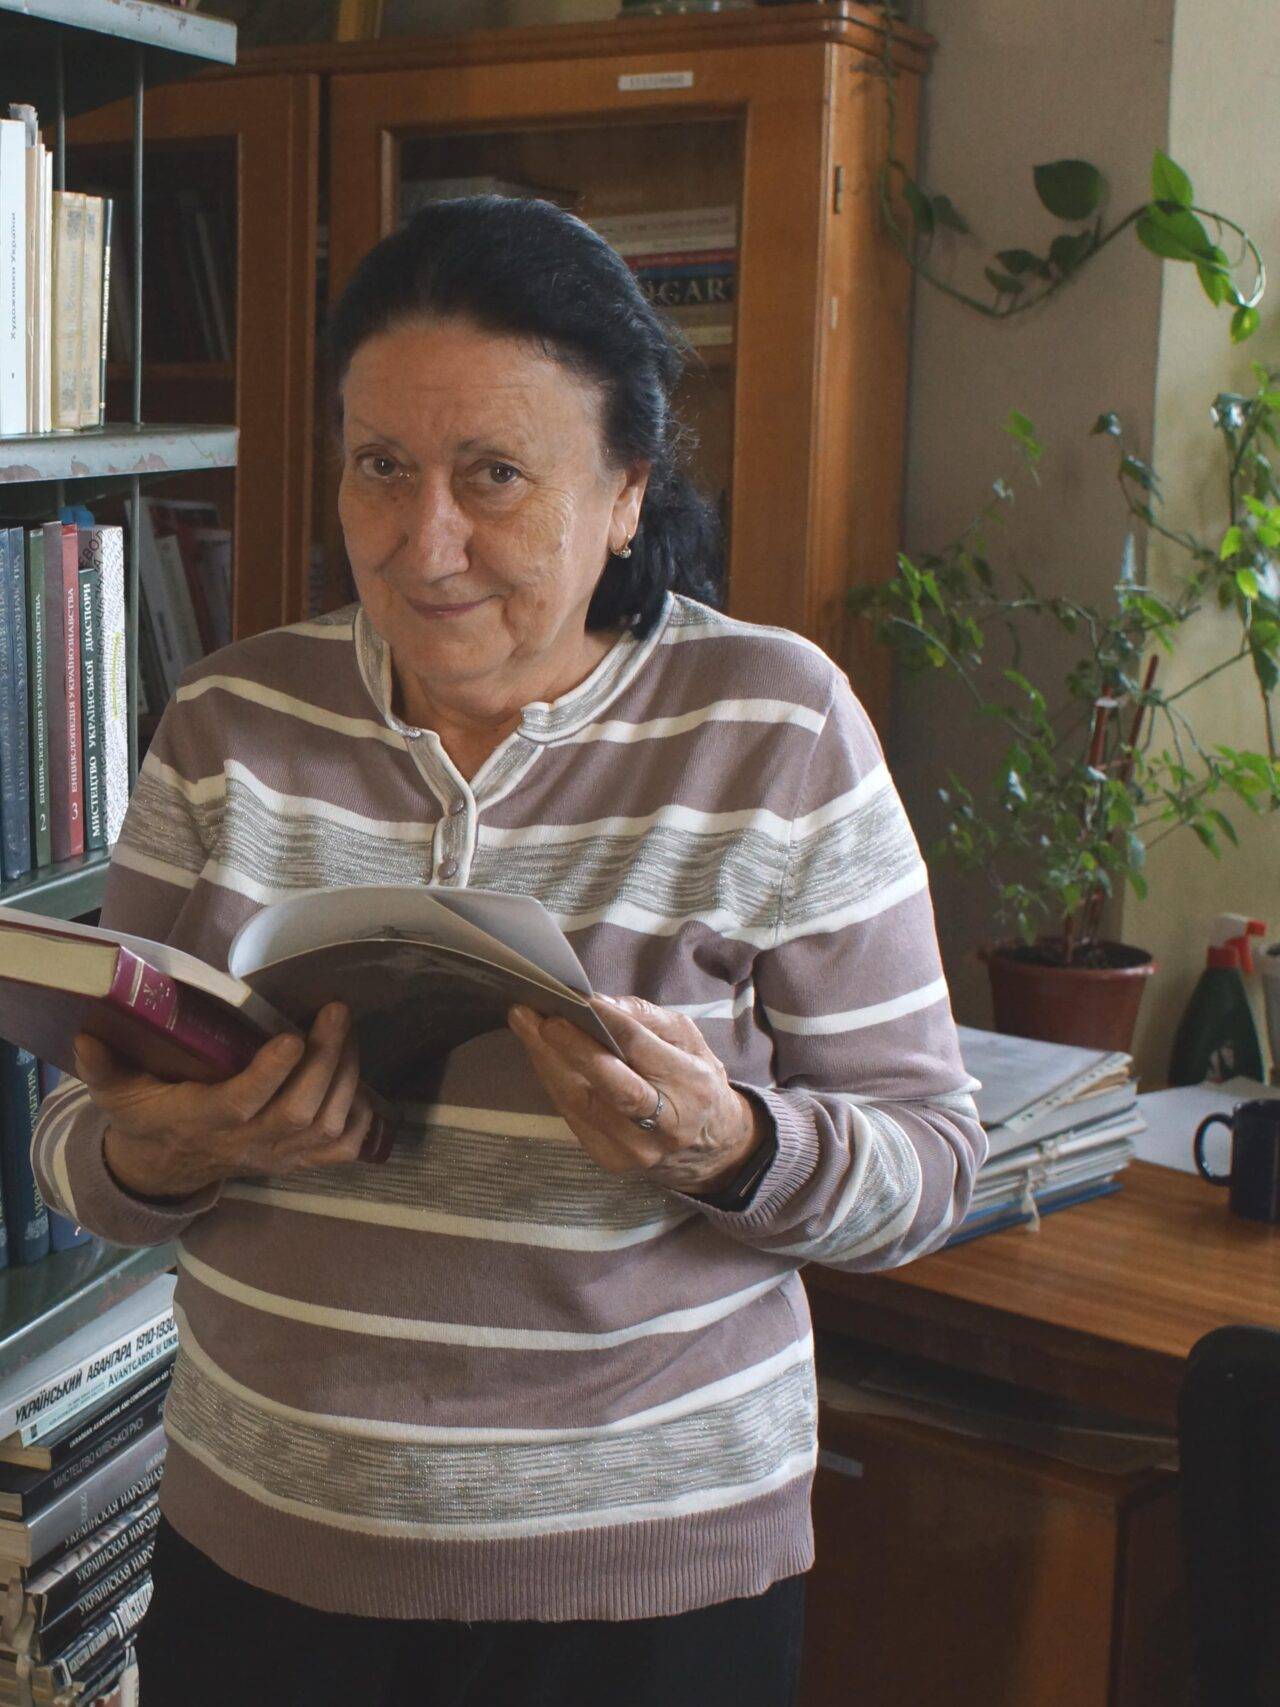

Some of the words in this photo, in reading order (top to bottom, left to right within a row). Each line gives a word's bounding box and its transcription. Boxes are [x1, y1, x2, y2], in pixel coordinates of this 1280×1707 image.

[35, 594, 44, 710] УКРАЇНОЗНАВСТВА
[67, 588, 76, 699] УКРАЇНОЗНАВСТВА
[83, 583, 93, 651] ДІАСПОРИ
[85, 660, 96, 747] УКРАЇНСЬКОЇ
[36, 714, 46, 804] ЕНЦИКЛОПЕДІЯ
[69, 704, 78, 793] ЕНЦИКЛОПЕДІЯ
[40, 814, 47, 831] 2
[71, 802, 79, 820] 3
[88, 756, 101, 836] МИСТЕЦТВО
[15, 1369, 82, 1426] УКРАЇНСЬКИЙ
[86, 1341, 132, 1383] АВАНГАРД
[135, 1317, 175, 1351] 1910-1930
[107, 1350, 155, 1388] AVANTGARDE
[53, 1452, 95, 1490] МИСТЕЦТВО
[95, 1428, 130, 1459] КИЇВСЬКОЇ
[64, 1500, 120, 1550] УКРАИНСКАЯ
[120, 1463, 164, 1509] НАРОДНАЯ
[75, 1533, 129, 1585] УКРАИНСКАЯ
[78, 1565, 131, 1616] УКРАИНСКАЯ
